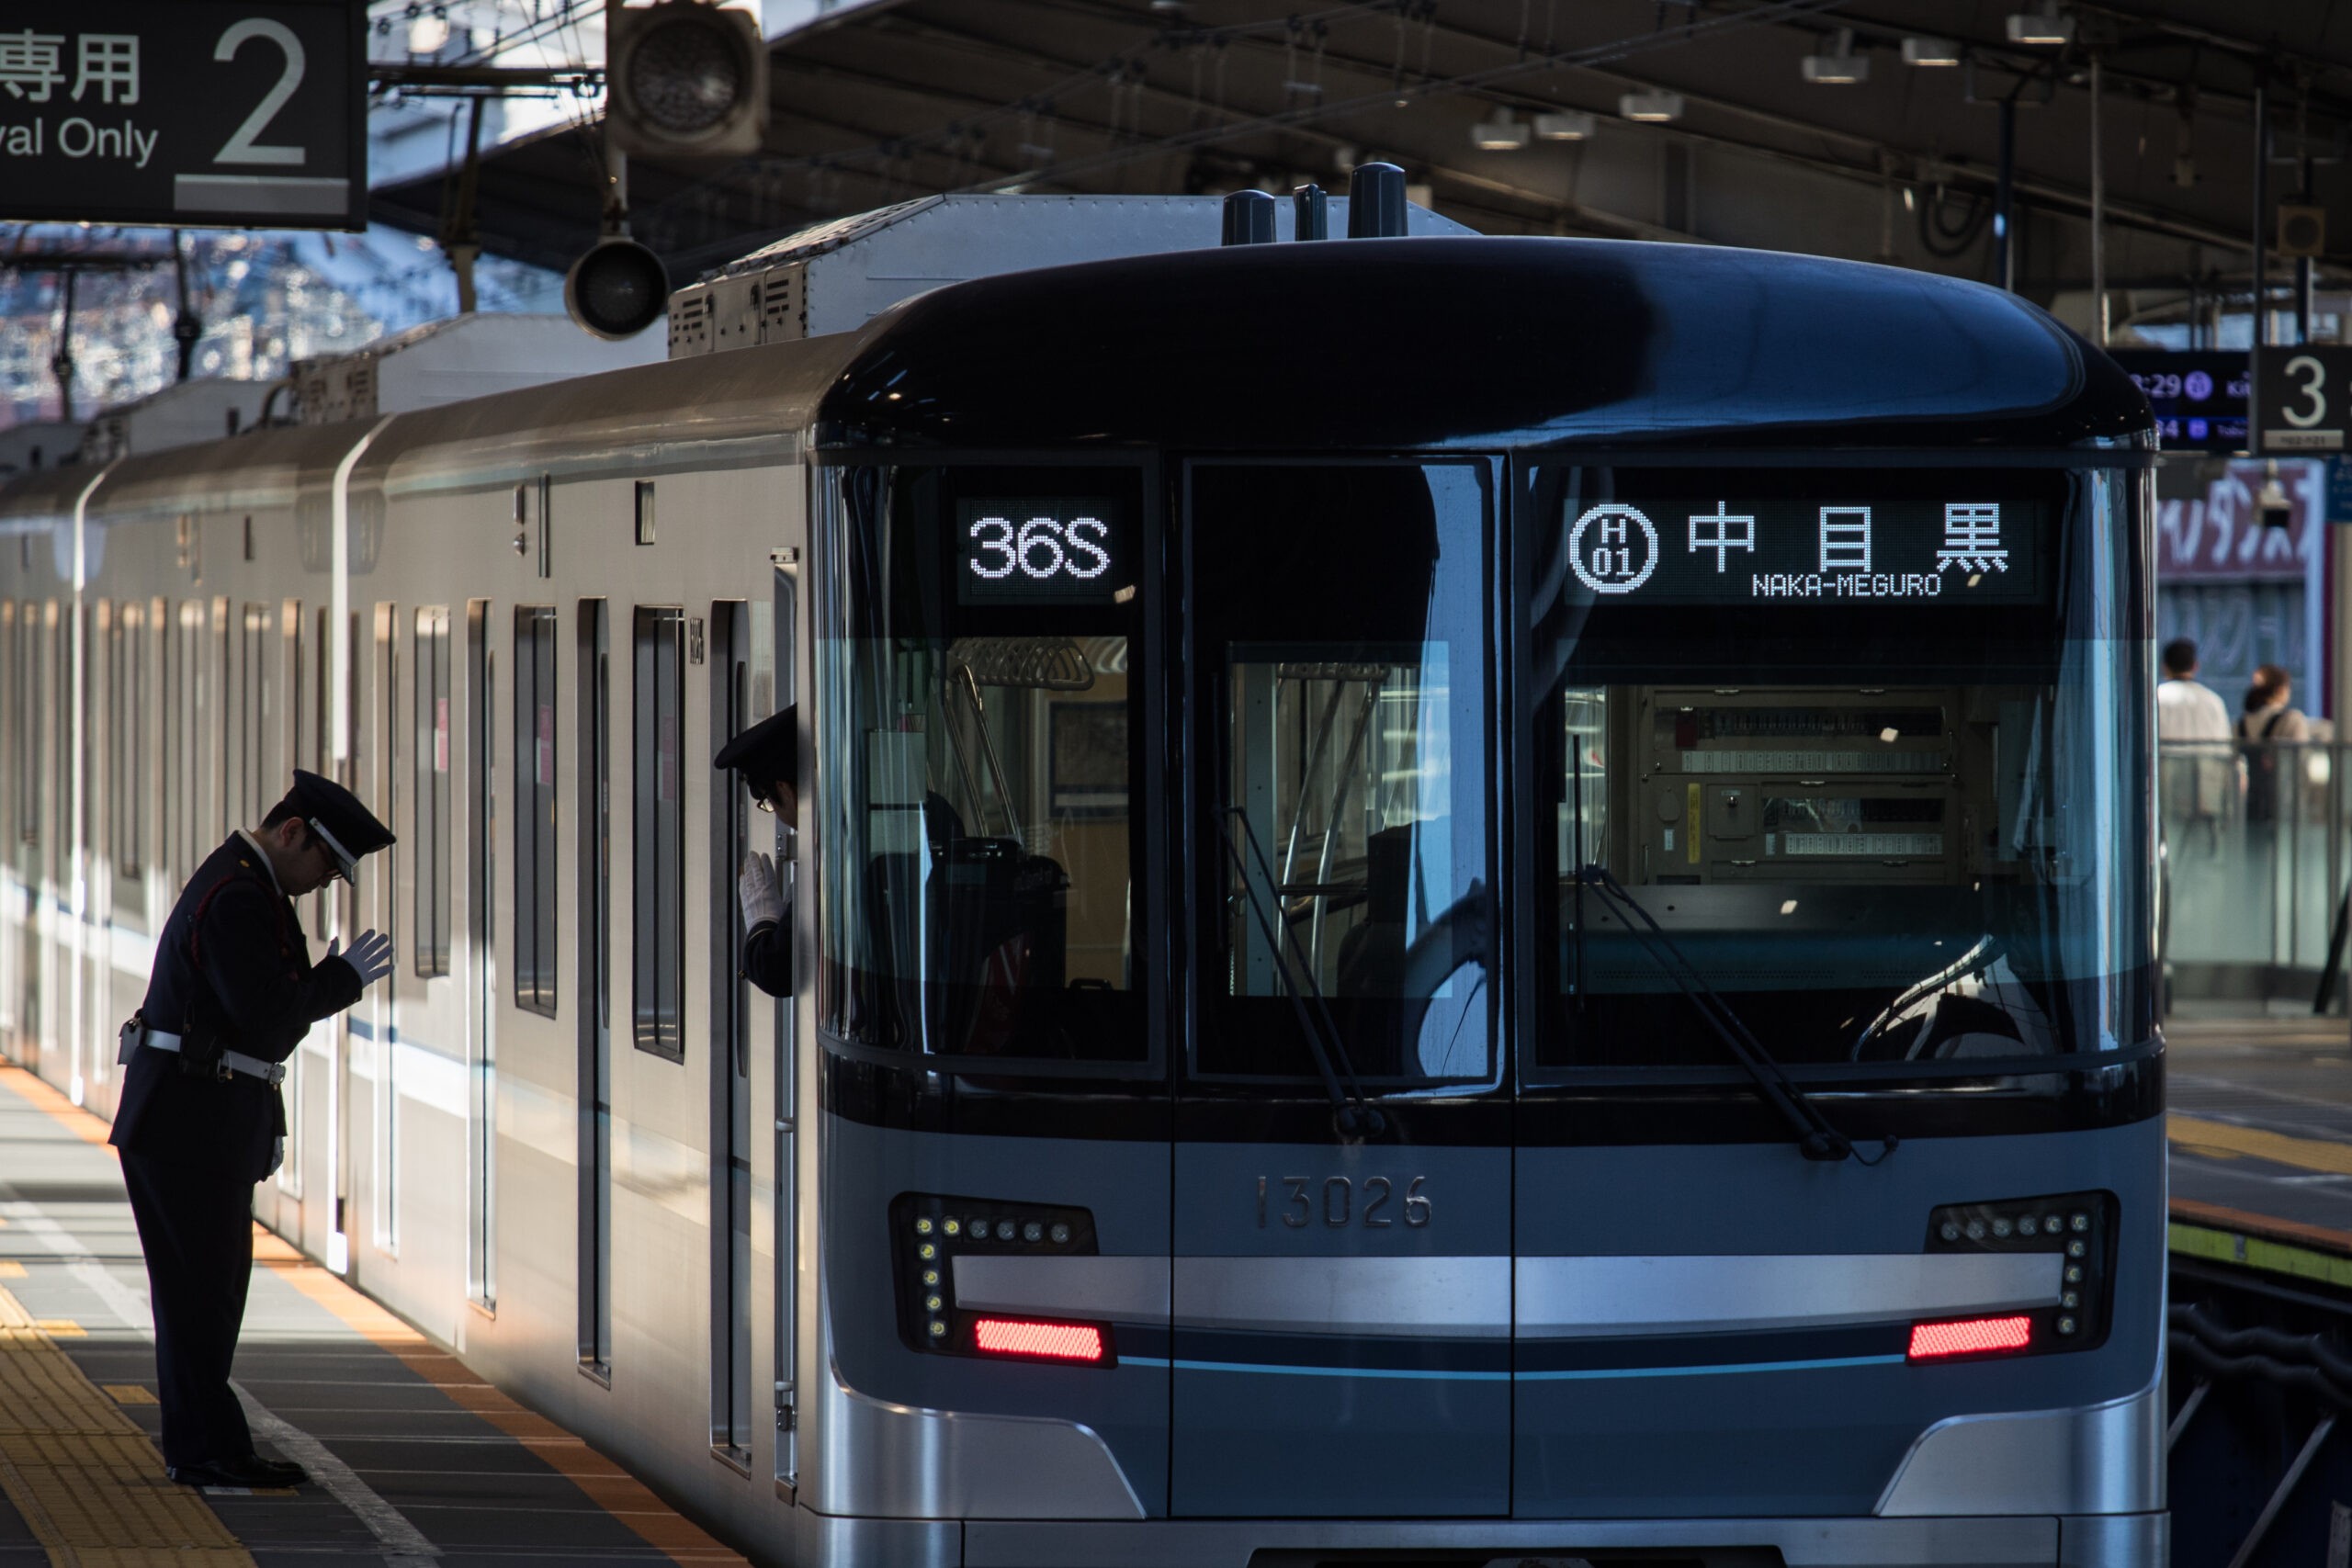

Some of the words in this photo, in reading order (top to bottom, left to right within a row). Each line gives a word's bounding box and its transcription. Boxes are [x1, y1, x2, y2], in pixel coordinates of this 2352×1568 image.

[0, 28, 141, 107] 専用
[213, 17, 306, 164] 2
[57, 117, 159, 169] Only
[2281, 355, 2327, 429] 3
[969, 516, 1112, 579] 36S
[1600, 518, 1627, 544] H
[1688, 500, 2009, 573] 中目黒
[1591, 547, 1635, 577] 01
[1752, 573, 1942, 597] NAKA-MEGURO
[1256, 1175, 1432, 1228] 13026
